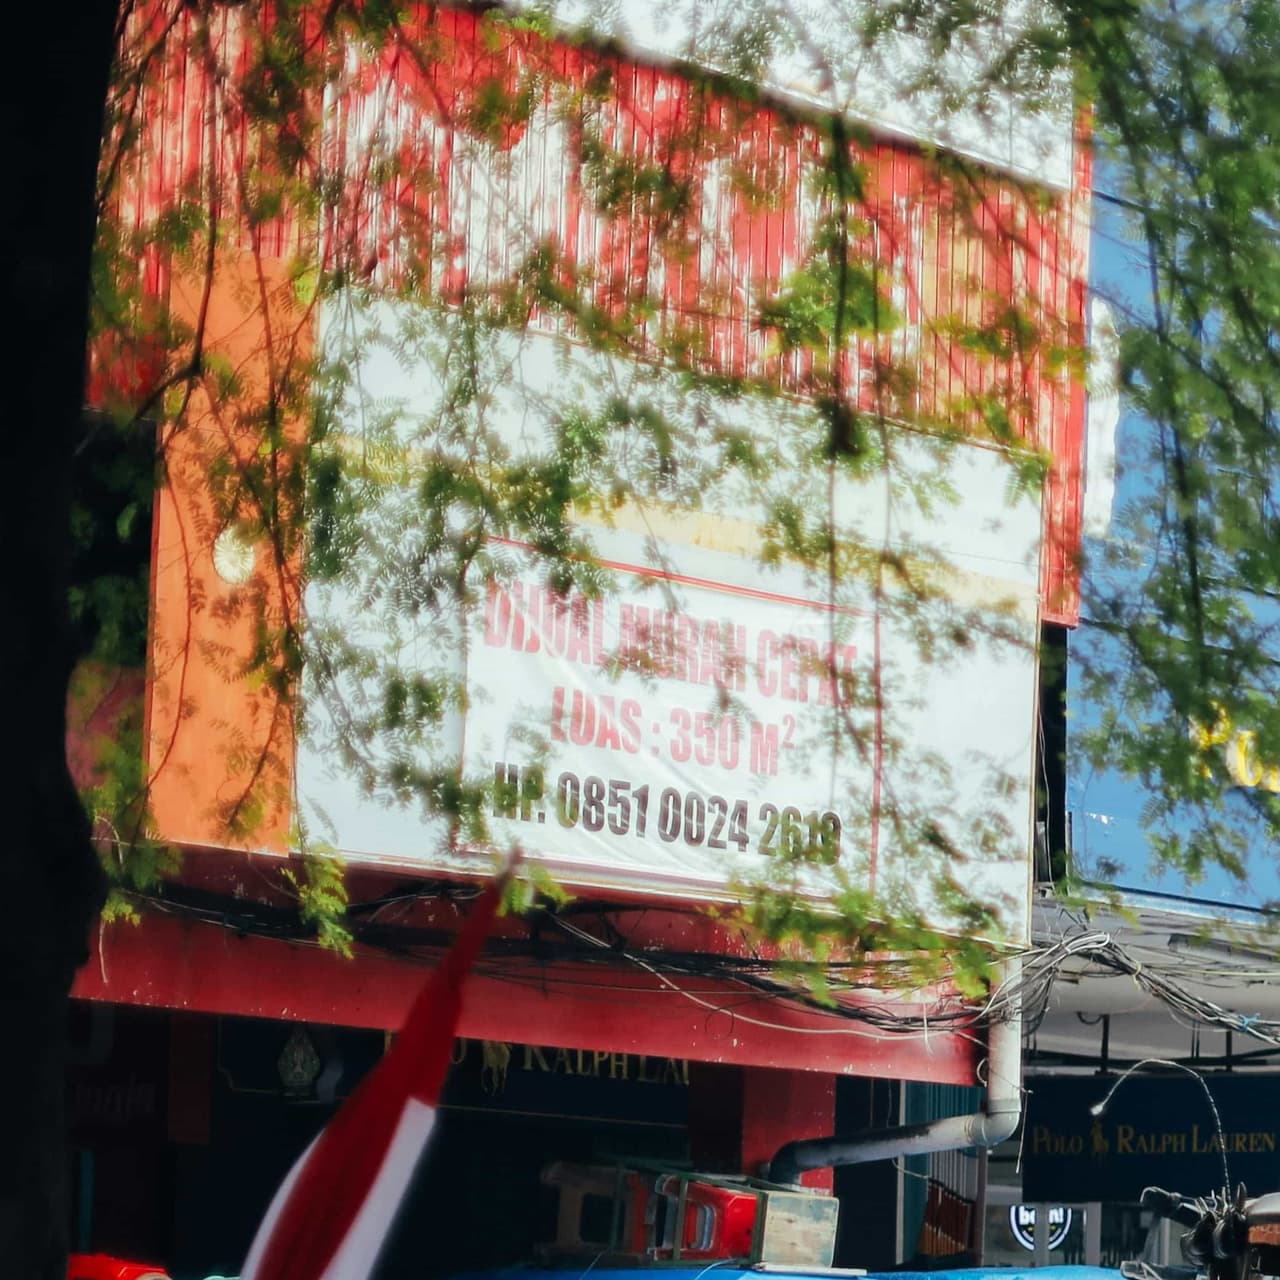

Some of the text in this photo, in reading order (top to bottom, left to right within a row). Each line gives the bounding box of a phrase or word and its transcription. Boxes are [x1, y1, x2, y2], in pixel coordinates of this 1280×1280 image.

[619, 602, 747, 692] MURAH
[550, 686, 643, 754] LUAS
[669, 706, 741, 770] 350
[557, 770, 650, 838] 0851
[657, 786, 750, 852] 0024
[1116, 1124, 1188, 1154] RALPH
[1191, 1124, 1277, 1154] LAUREN
